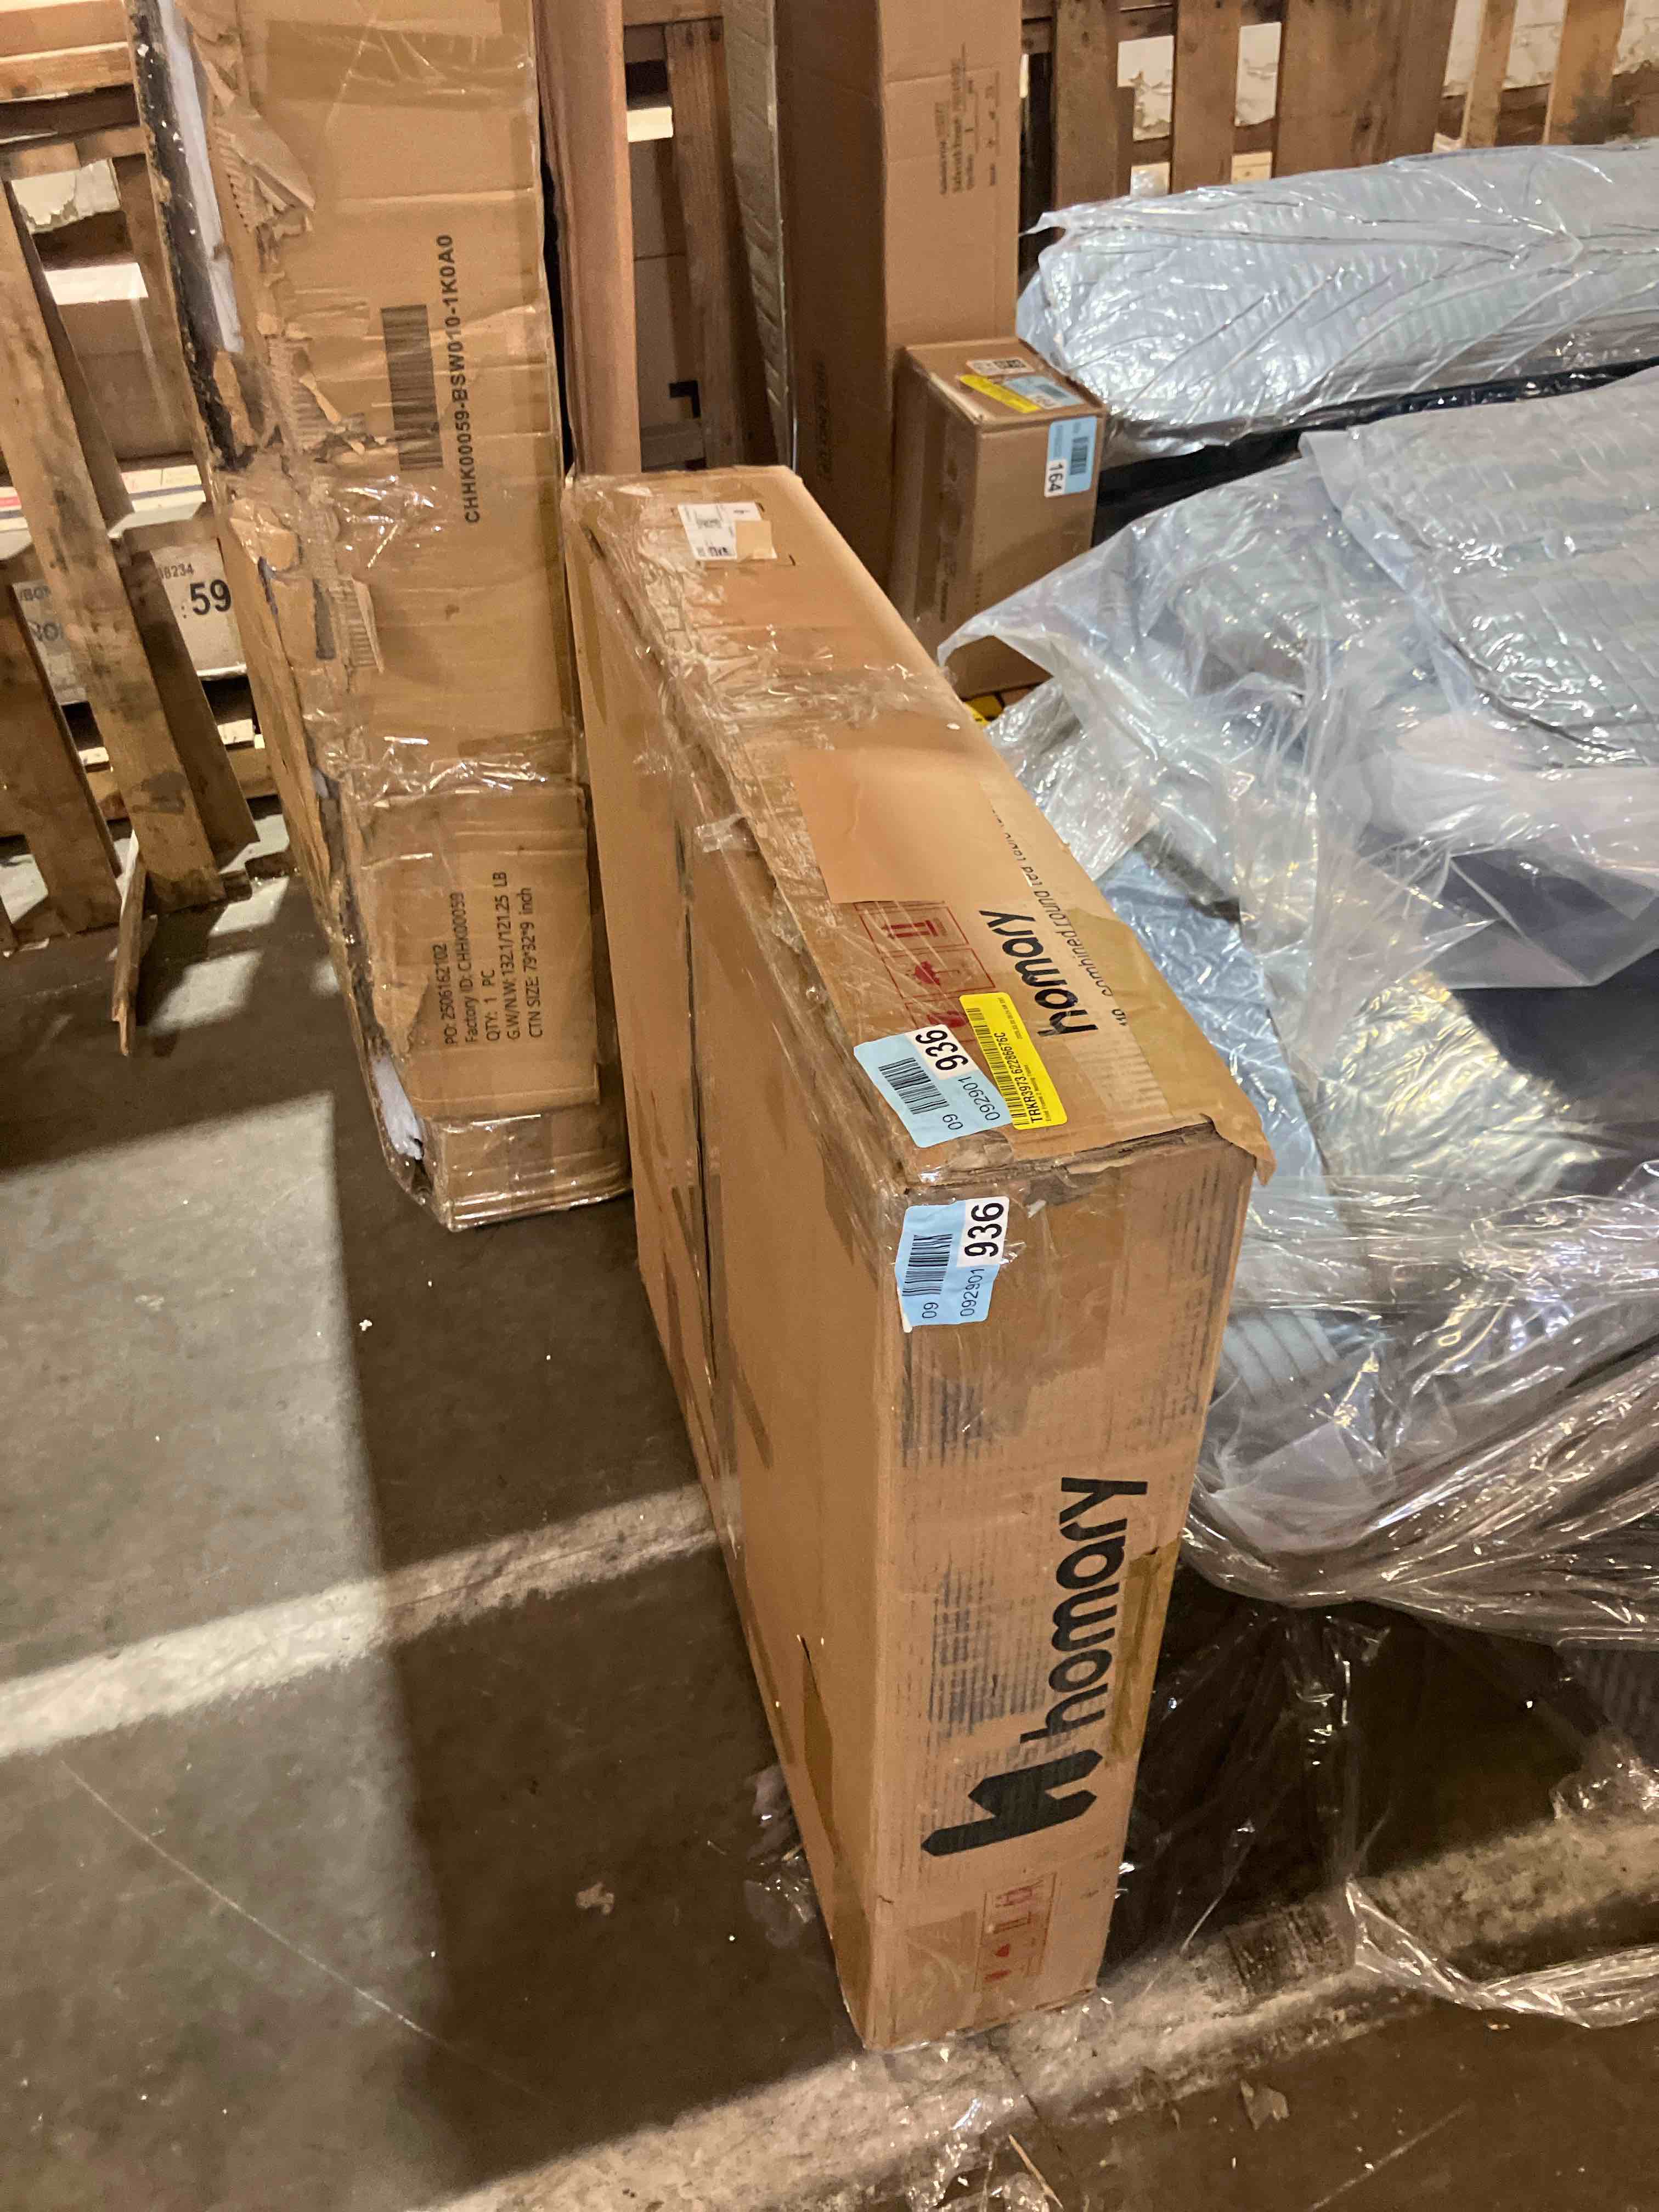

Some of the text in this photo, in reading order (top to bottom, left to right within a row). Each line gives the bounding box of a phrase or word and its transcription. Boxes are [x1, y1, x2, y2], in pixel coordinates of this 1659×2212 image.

[1048, 463, 1063, 493] 164
[189, 579, 232, 616] 59
[493, 872, 507, 887] LB
[517, 887, 533, 915] inch
[481, 969, 495, 987] PC
[978, 909, 1099, 1037] homary
[465, 996, 479, 1043] Factory
[484, 1011, 501, 1042] QTY:
[527, 1011, 543, 1039] CTN
[915, 1029, 969, 1071] 936
[957, 1076, 1001, 1121] 092901
[942, 1113, 964, 1131] 09
[964, 1202, 1004, 1258] 936
[959, 1267, 985, 1317] 092901
[922, 1301, 940, 1319] 09
[1020, 1476, 1148, 1743] homary
